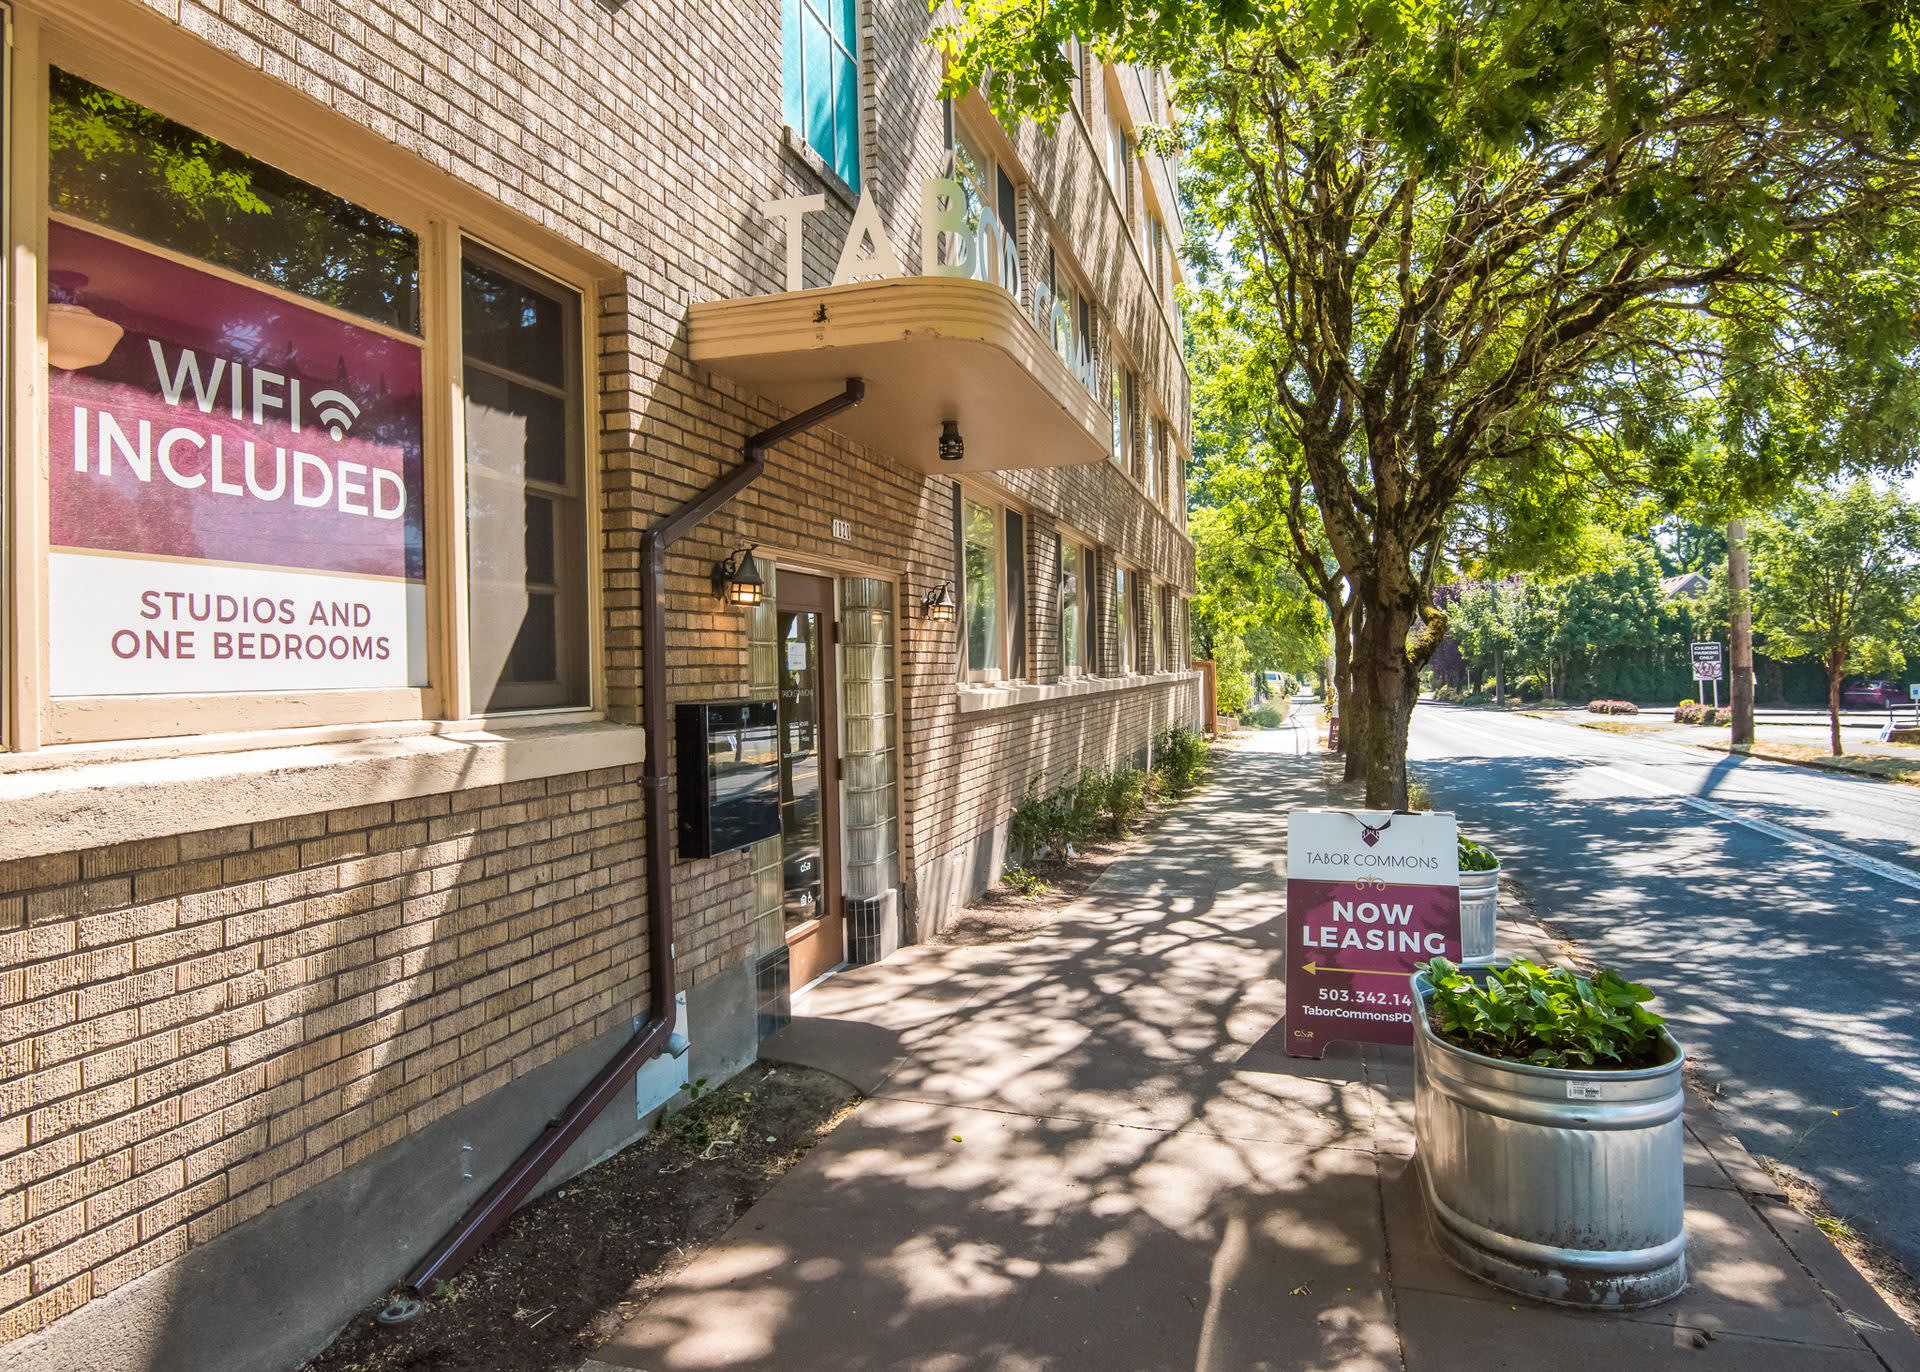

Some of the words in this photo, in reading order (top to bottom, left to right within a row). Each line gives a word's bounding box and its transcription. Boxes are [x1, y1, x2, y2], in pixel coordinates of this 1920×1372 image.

[765, 178, 1021, 303] TABOR
[149, 339, 301, 433] WIFI
[74, 406, 407, 519] INCLUDED
[140, 590, 296, 625] STUDIOS
[308, 601, 371, 628] AND
[111, 629, 195, 660] ONE
[214, 631, 390, 660] BEDROOMS
[1307, 852, 1350, 866] TABOR
[1354, 854, 1439, 869] COMMONS
[1333, 901, 1414, 925] NOW
[1303, 926, 1446, 954] LEASING
[1318, 989, 1412, 1007] 503.342.14
[1302, 1006, 1412, 1023] TaborCommonsPD
